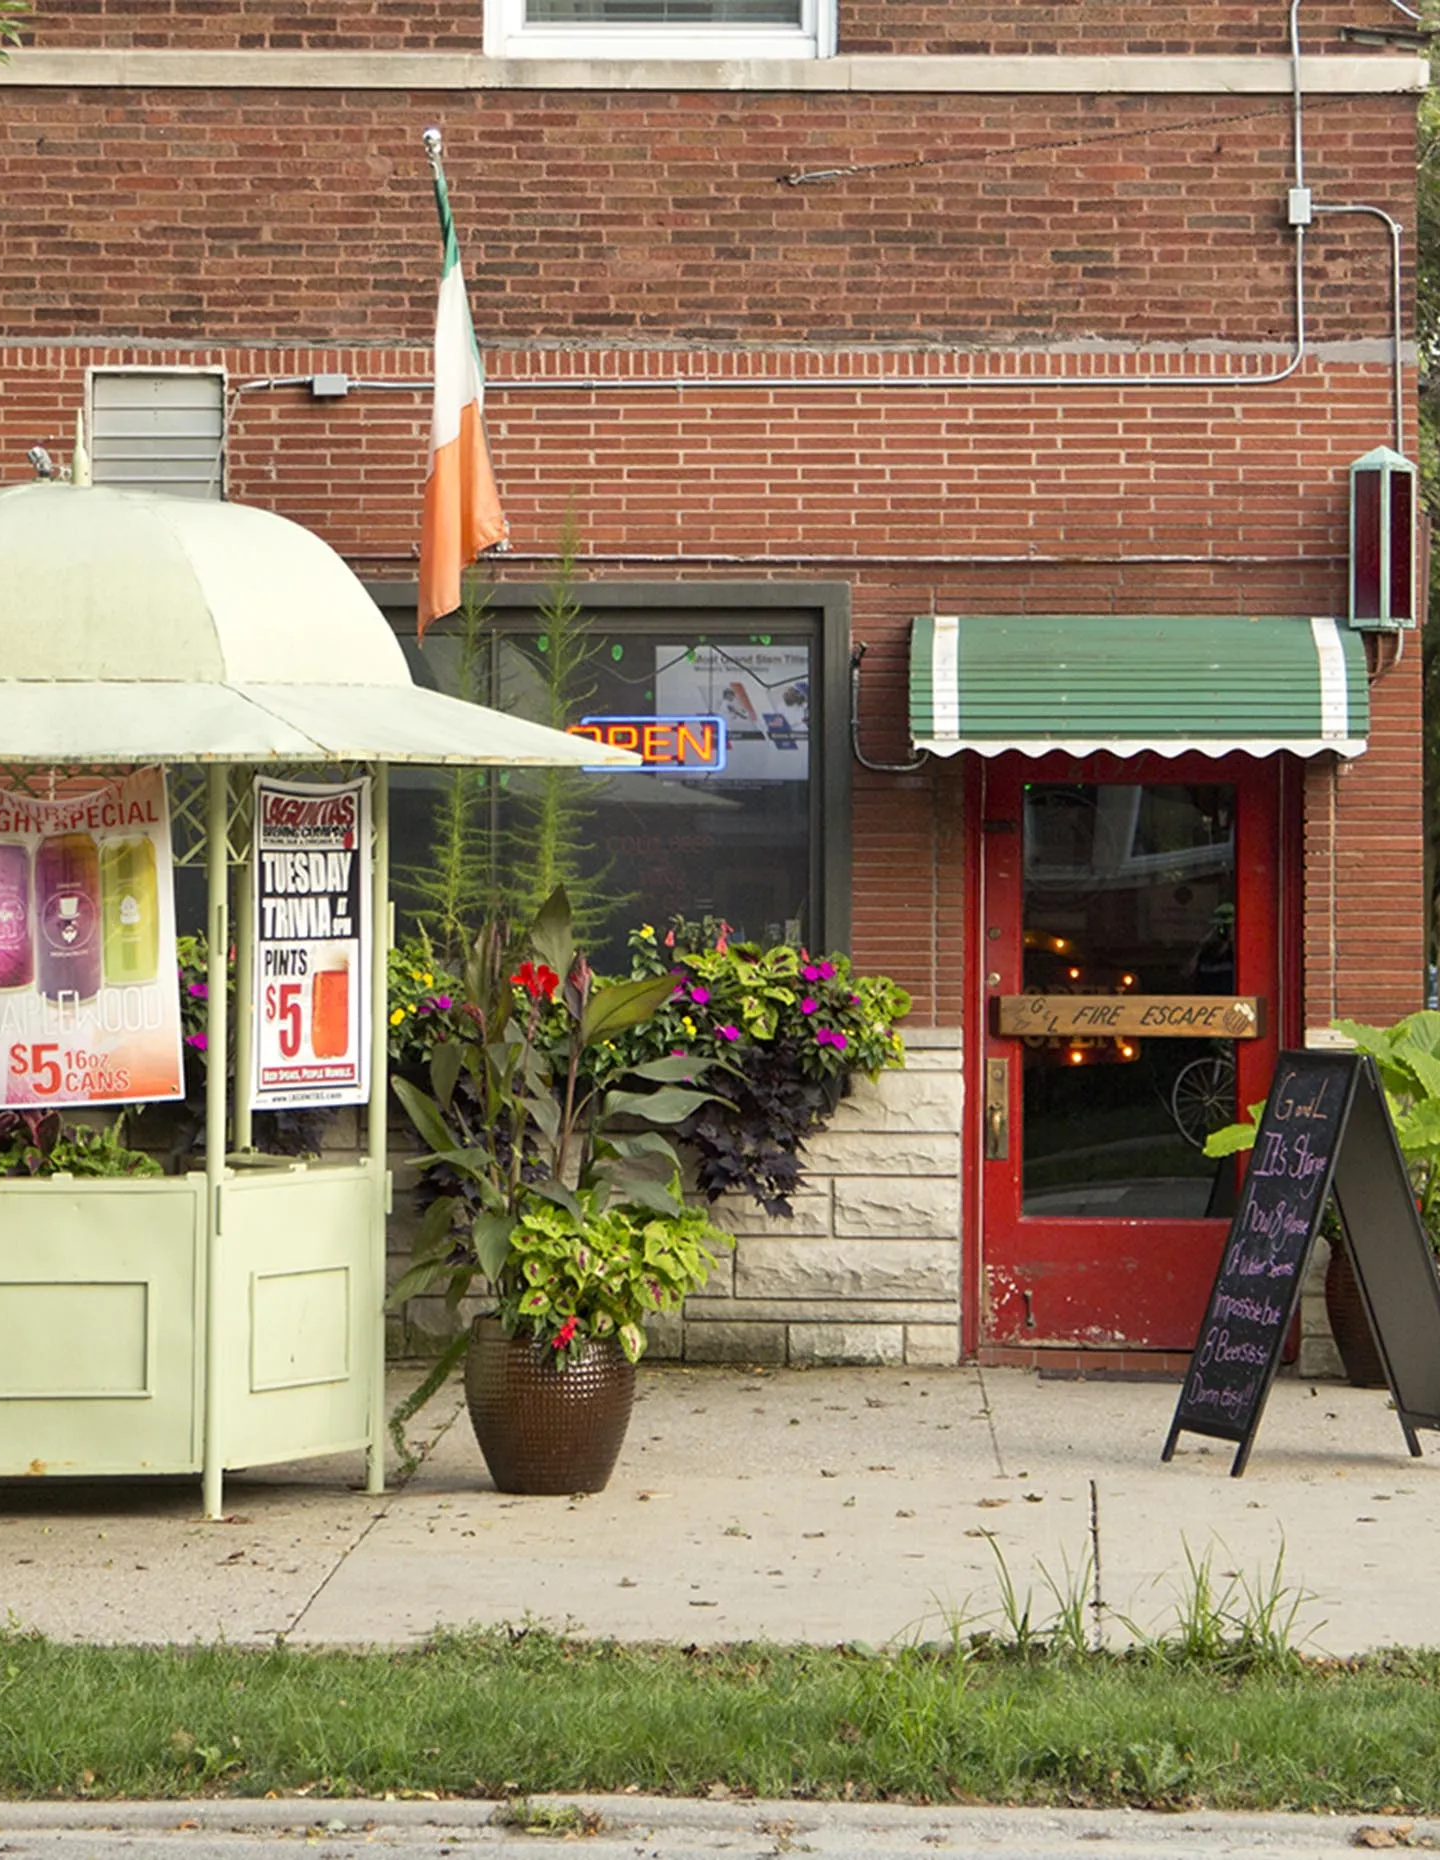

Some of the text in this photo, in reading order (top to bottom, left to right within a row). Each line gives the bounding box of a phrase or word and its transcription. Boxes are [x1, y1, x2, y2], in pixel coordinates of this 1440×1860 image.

[261, 851, 353, 894] TUESDAY
[261, 896, 332, 939] TRIVIA
[264, 948, 308, 977] PINTS
[264, 983, 303, 1058] $5
[1072, 1005, 1125, 1026] FIRE
[1140, 1005, 1225, 1026] ESCAPE
[9, 1042, 62, 1095] $5
[64, 1070, 130, 1093] CANS
